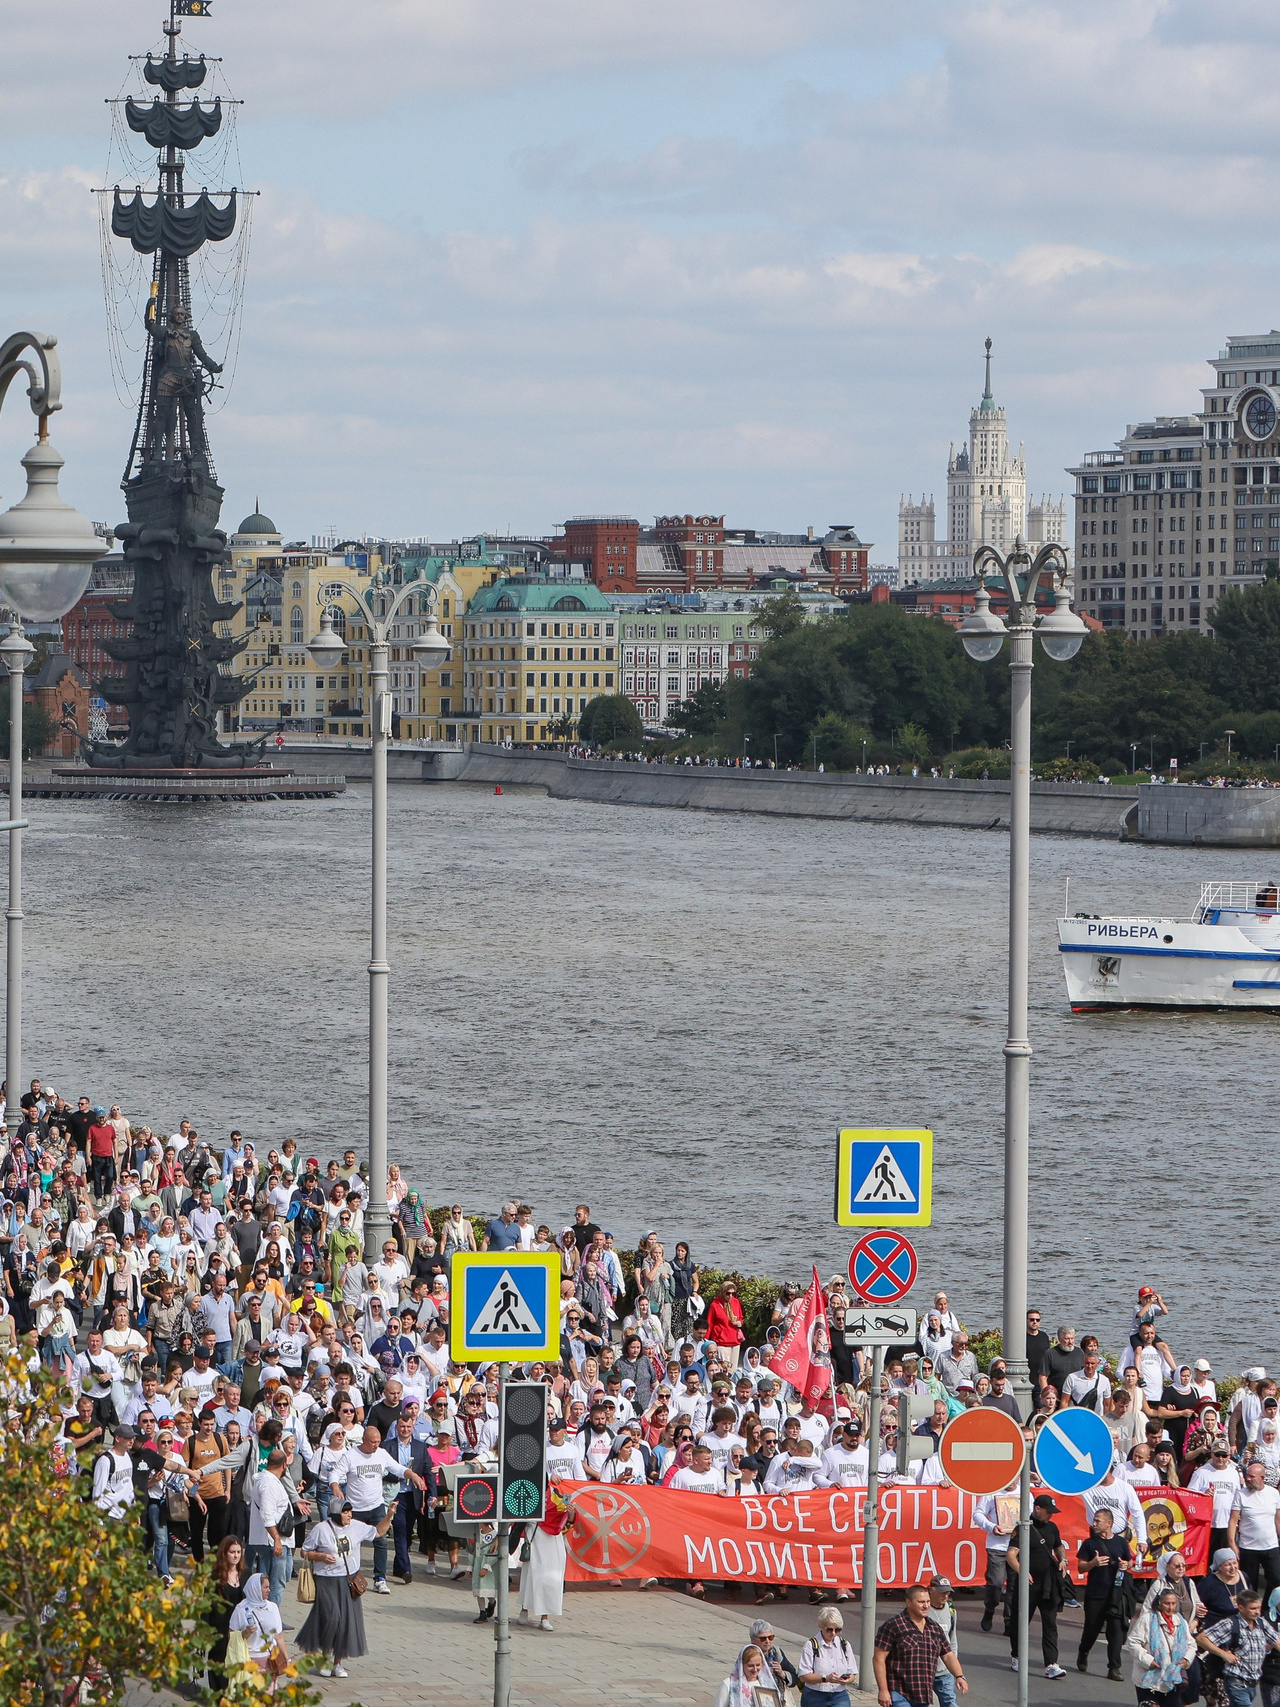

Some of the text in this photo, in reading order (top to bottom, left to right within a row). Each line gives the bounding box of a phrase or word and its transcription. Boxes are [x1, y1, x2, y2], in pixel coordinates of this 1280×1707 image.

[1088, 924, 1158, 938] РИВЬЕРА
[741, 1495, 816, 1533] ВСЕ
[683, 1534, 838, 1583] МОЛИТЕ
[954, 1540, 977, 1582] О
